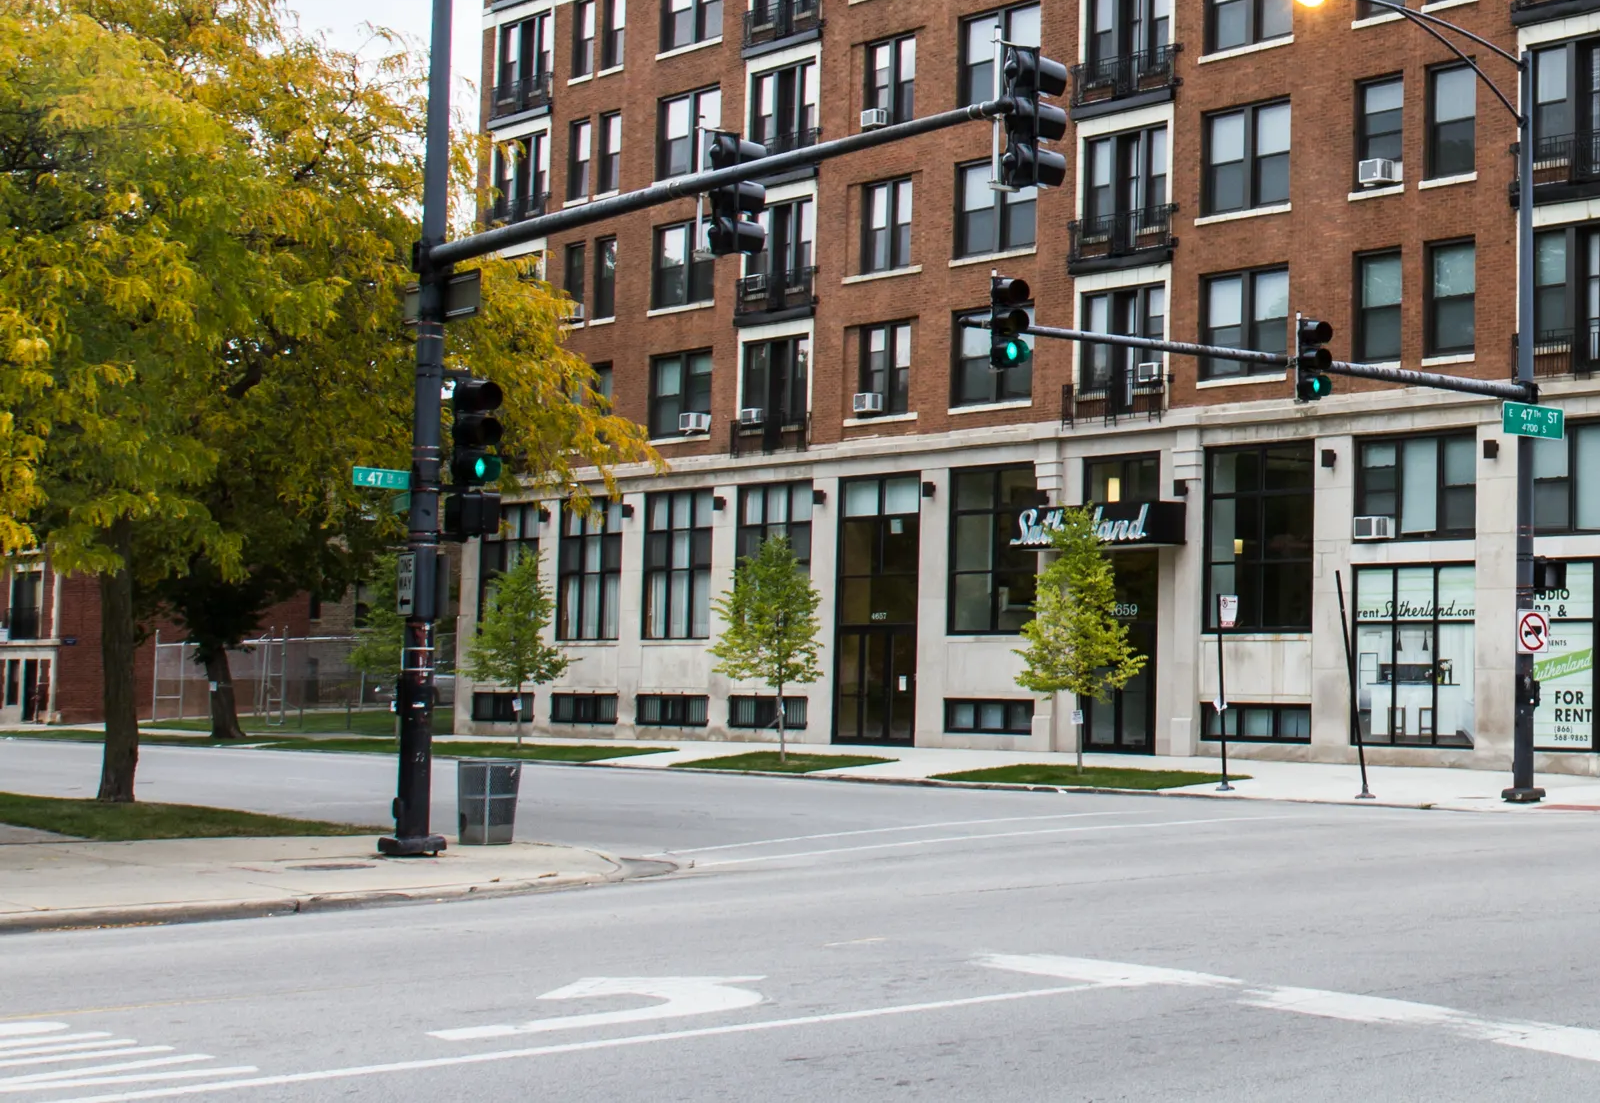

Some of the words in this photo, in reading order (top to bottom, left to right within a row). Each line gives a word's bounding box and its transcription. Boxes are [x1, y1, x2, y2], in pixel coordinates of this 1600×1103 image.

[1509, 408, 1514, 418] E
[1547, 411, 1559, 424] ST
[1521, 423, 1539, 433] 4700
[1542, 425, 1547, 434] S
[400, 558, 413, 574] ONE
[399, 576, 413, 591] WAY
[1555, 690, 1584, 705] FOR
[1555, 708, 1592, 723] RENT
[1554, 725, 1573, 734] (866)
